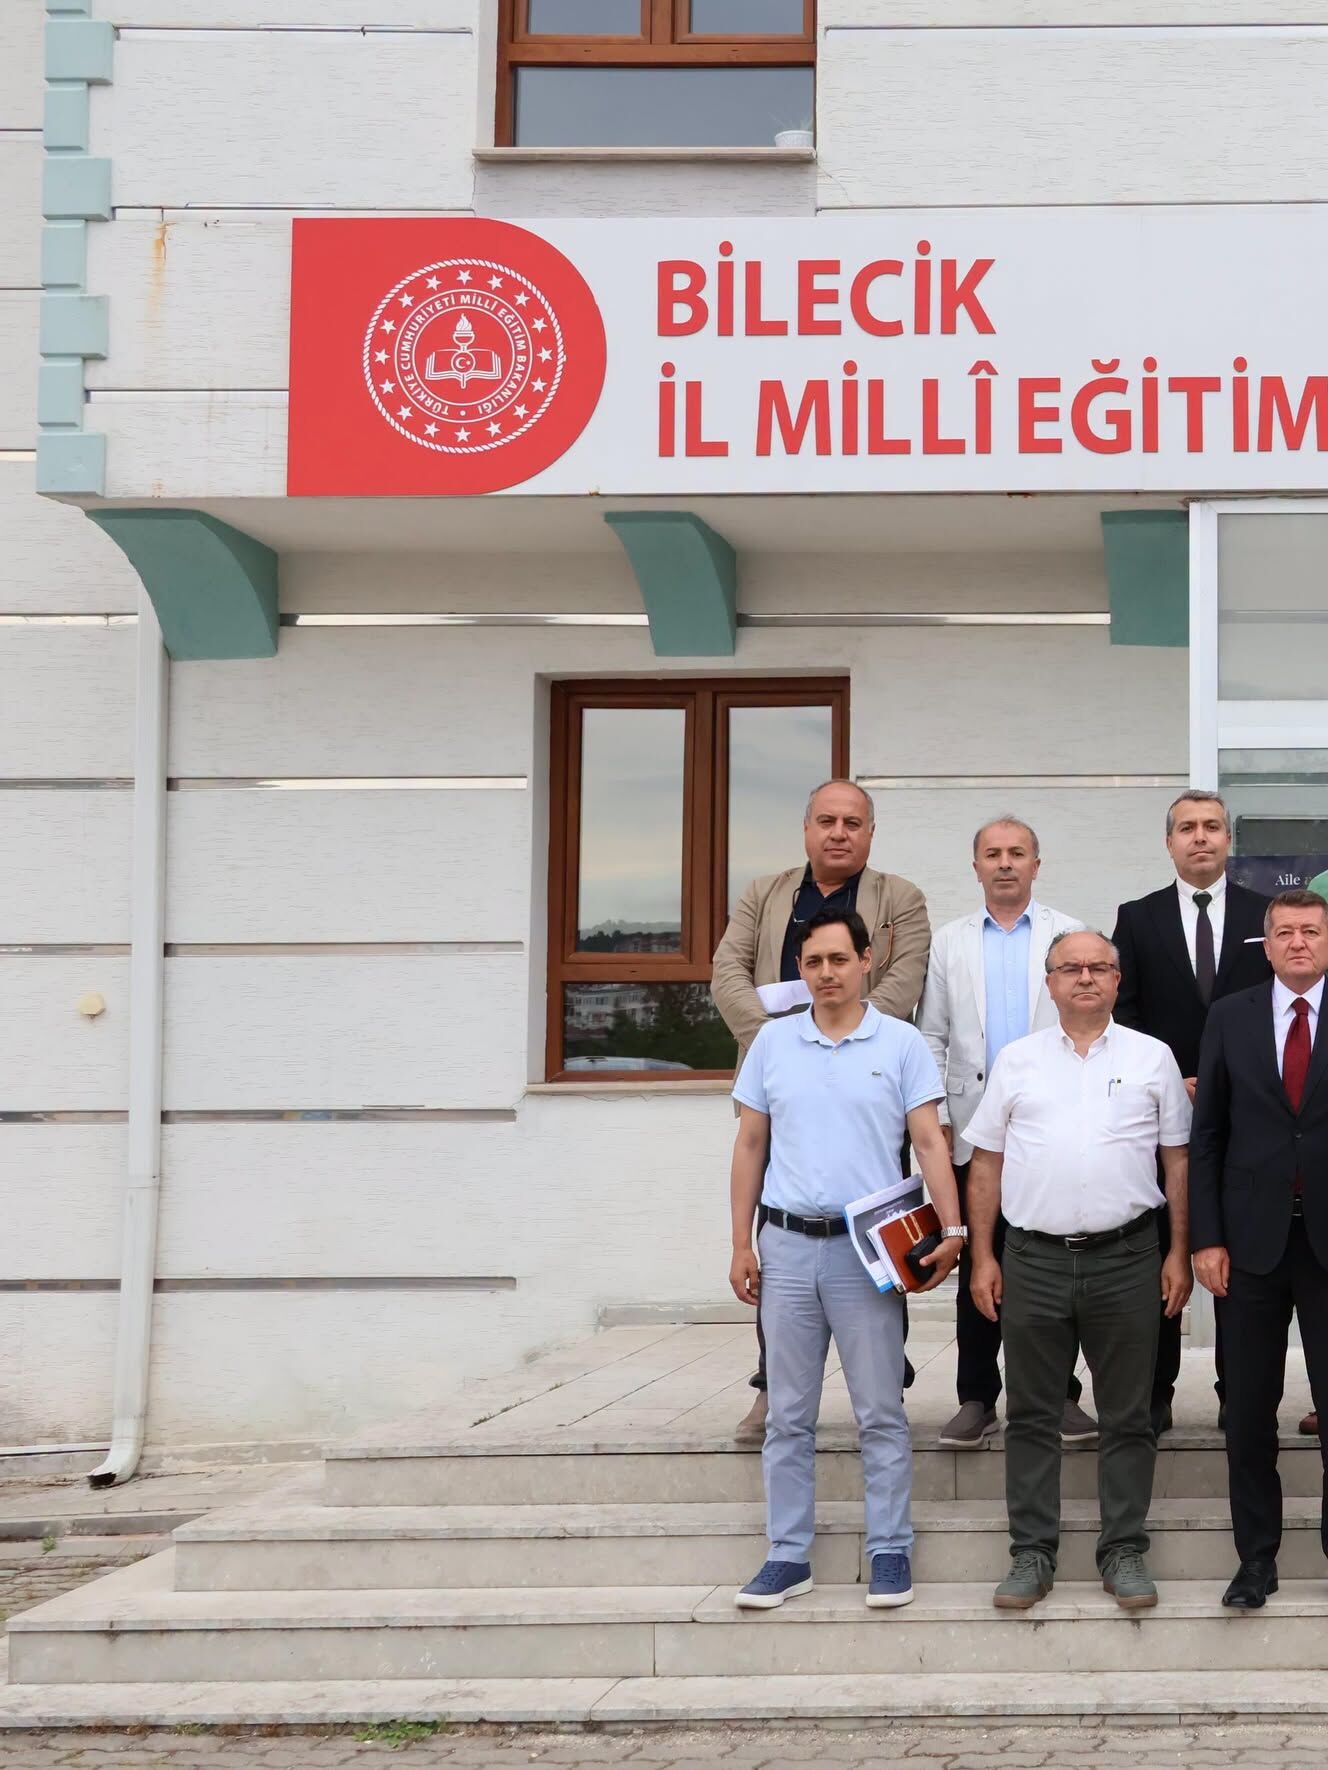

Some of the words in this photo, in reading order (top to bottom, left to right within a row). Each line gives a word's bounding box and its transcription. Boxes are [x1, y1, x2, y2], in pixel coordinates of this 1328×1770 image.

[460, 293, 498, 310] MİLLİ
[658, 240, 996, 337] BİLECİK
[400, 294, 455, 370] CUMHURİYETİ
[497, 308, 527, 351] EĞİTİM
[404, 373, 449, 416] TÜRKİYE
[477, 355, 527, 414] BAKANLIĞI
[659, 361, 729, 458] İL
[757, 359, 998, 457] MİLLÎ
[1275, 873, 1301, 886] Aile
